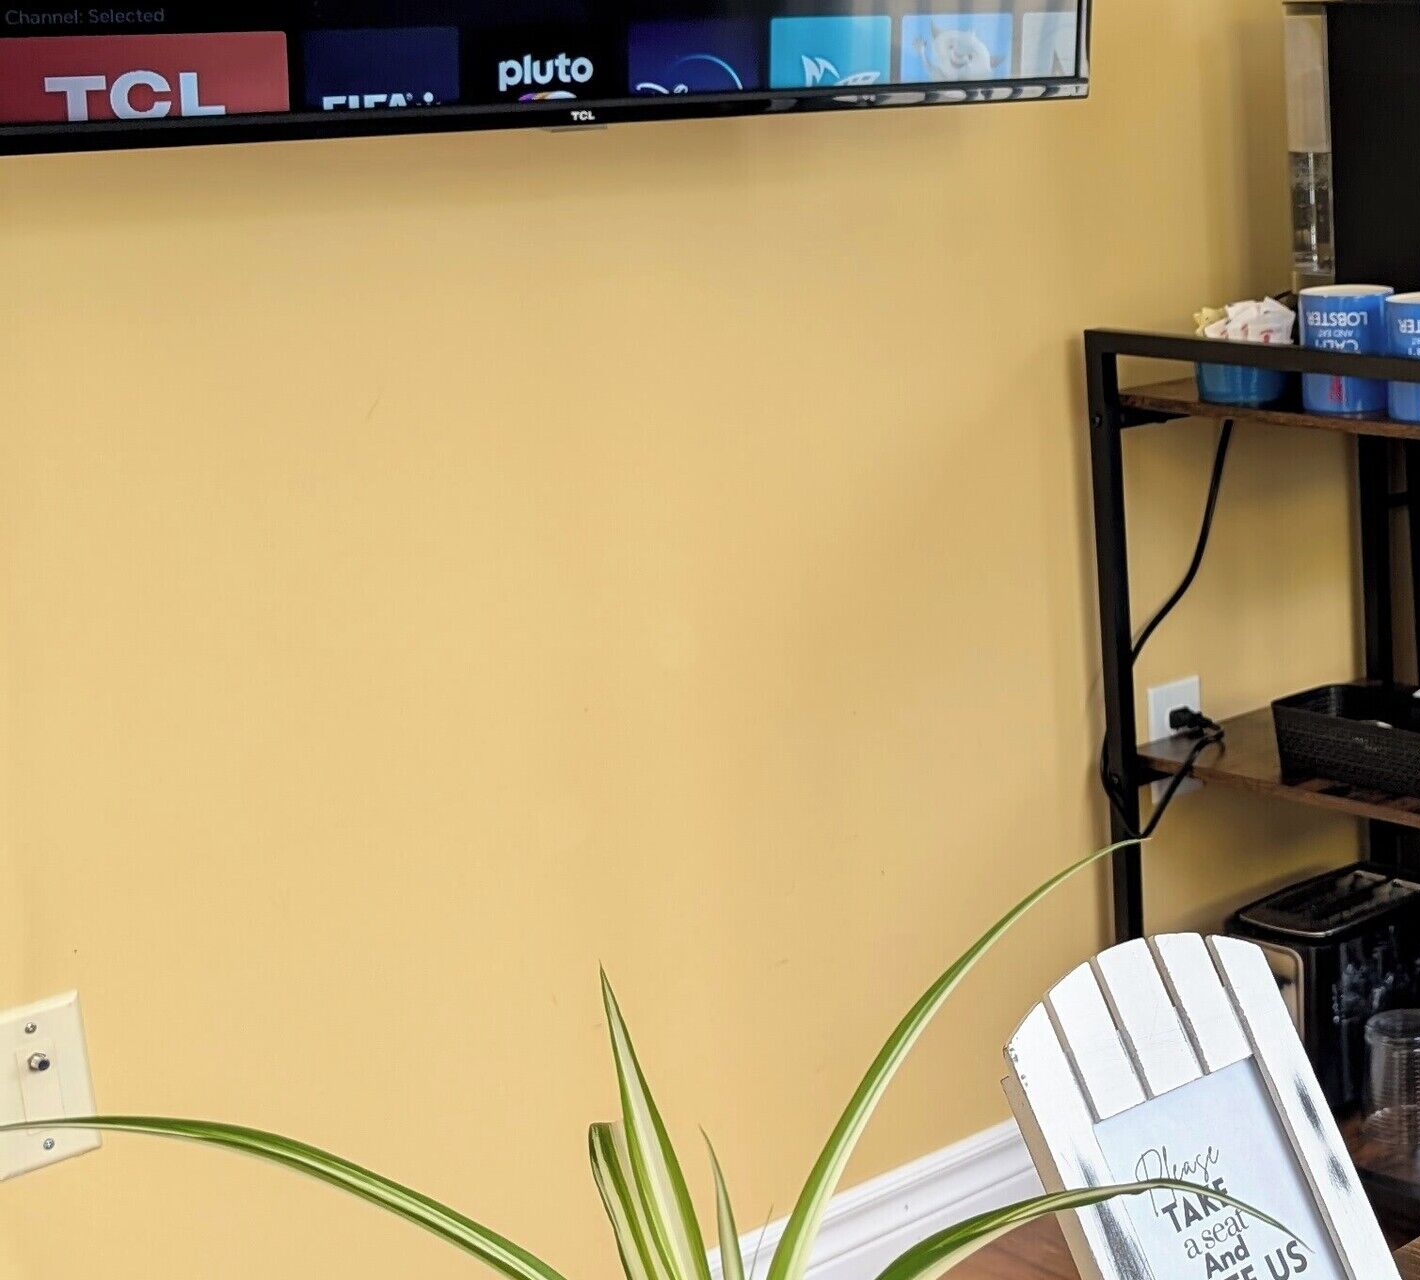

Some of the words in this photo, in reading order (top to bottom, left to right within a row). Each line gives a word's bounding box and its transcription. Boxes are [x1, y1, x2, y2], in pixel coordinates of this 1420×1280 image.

[87, 7, 165, 24] Selected
[498, 52, 594, 92] pluto
[43, 70, 227, 122] TCL
[570, 109, 596, 122] TCL
[1306, 310, 1369, 327] LOBSTER
[1134, 1145, 1220, 1218] Please
[1160, 1176, 1229, 1234] TAKE
[1183, 1237, 1203, 1260] a
[1201, 1208, 1250, 1250] seat
[1205, 1233, 1251, 1280] And
